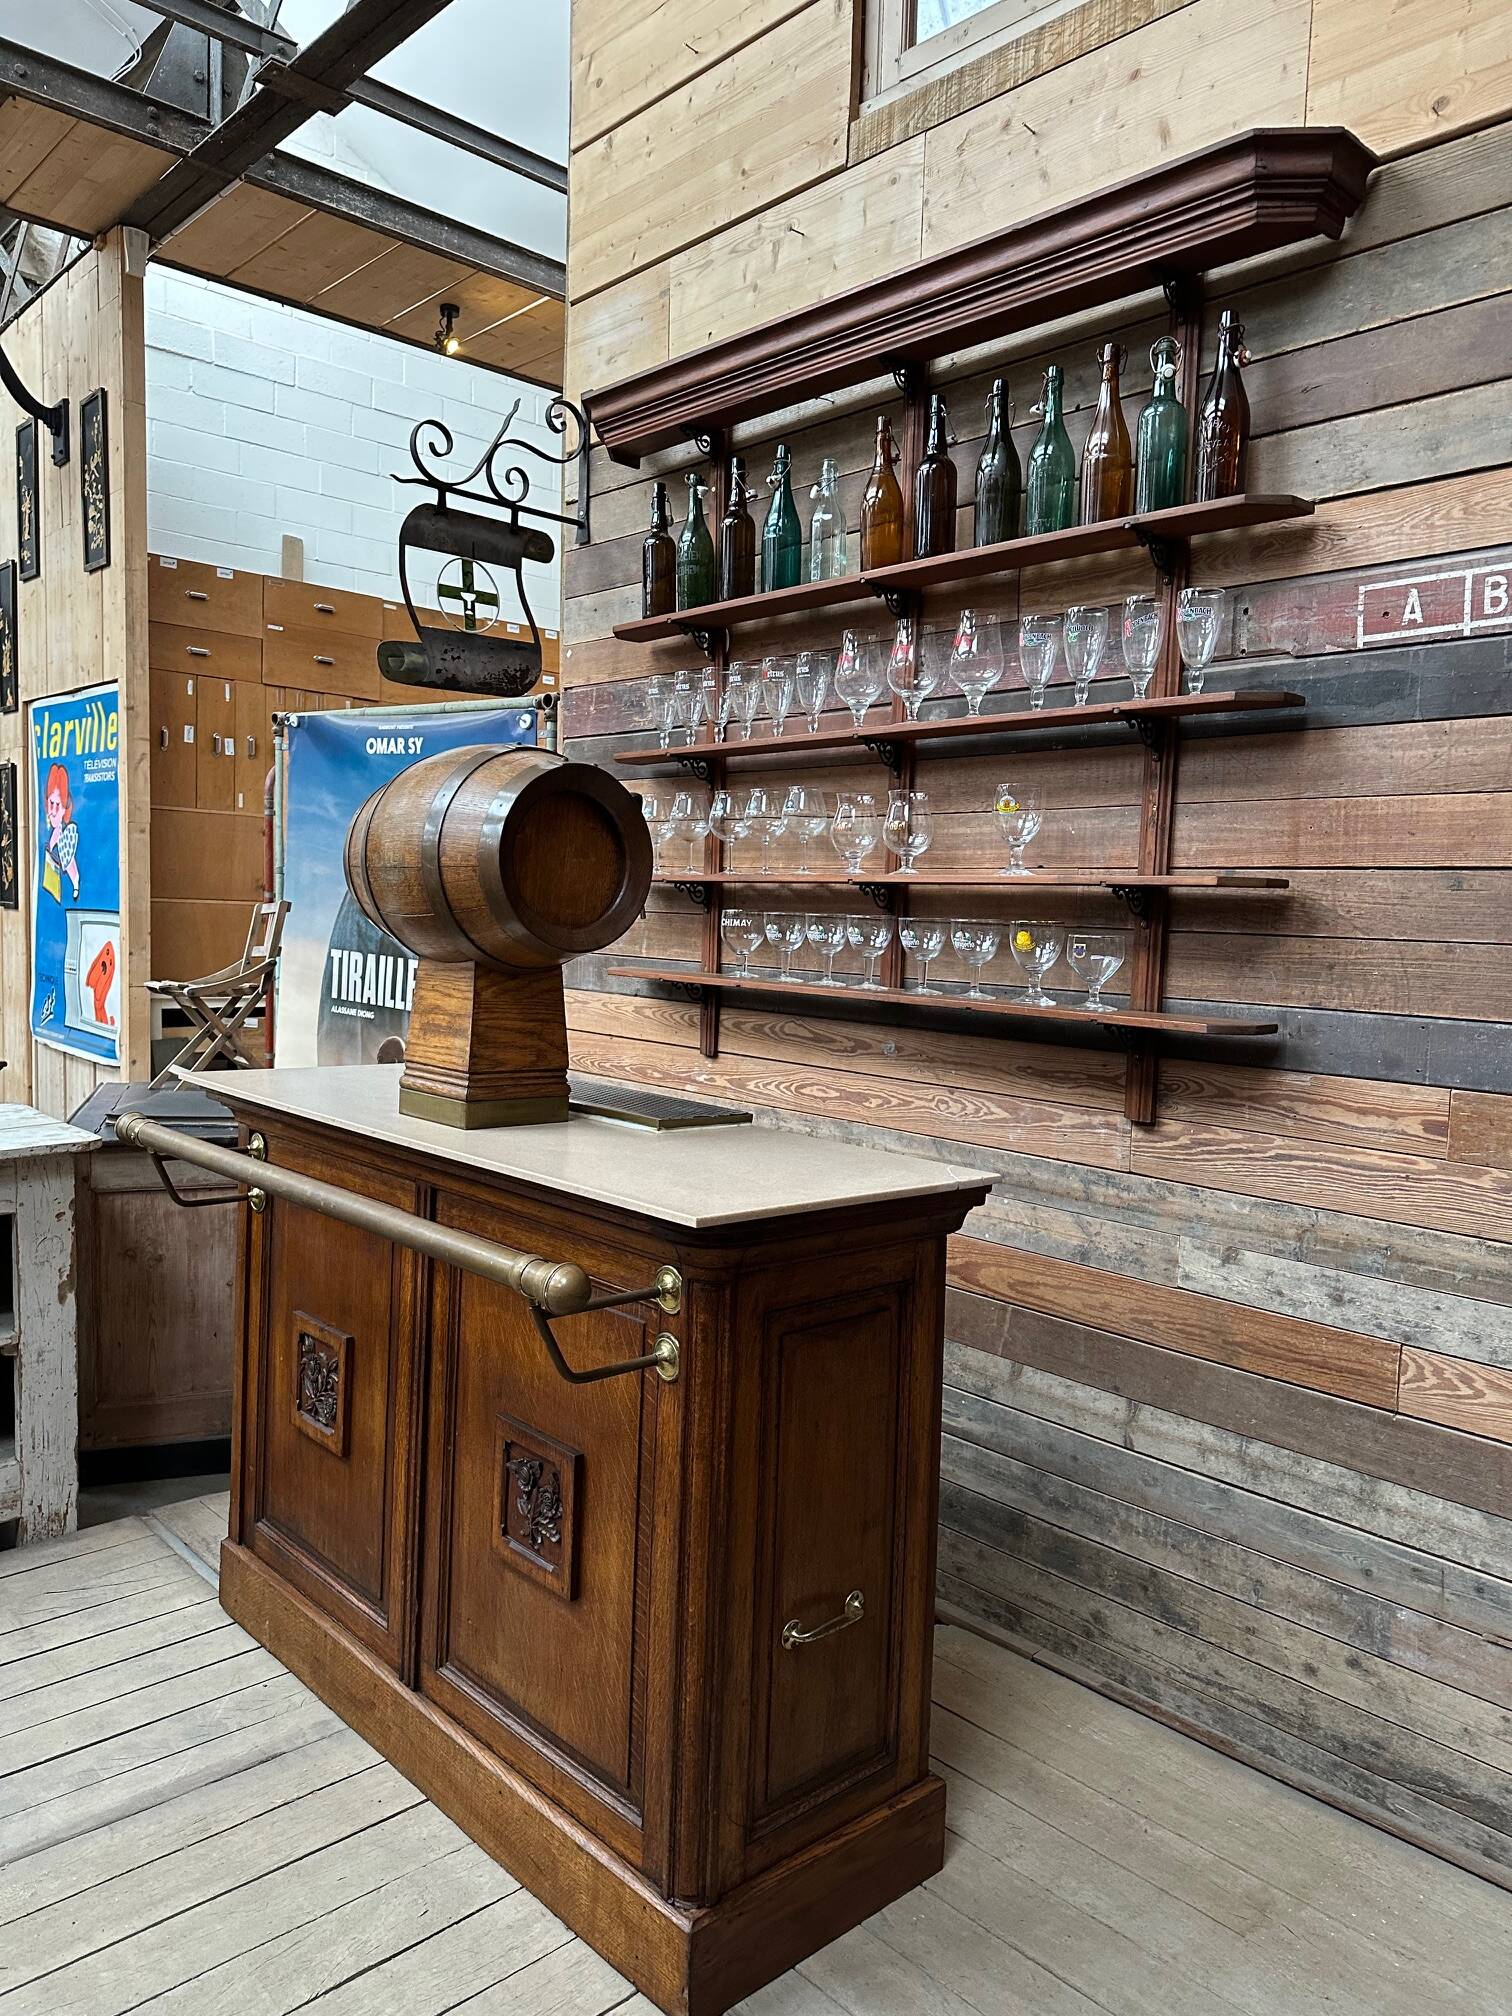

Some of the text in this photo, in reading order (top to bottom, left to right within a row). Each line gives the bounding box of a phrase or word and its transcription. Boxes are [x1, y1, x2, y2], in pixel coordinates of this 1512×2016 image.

[1483, 575, 1509, 615] B
[1402, 588, 1424, 626] A
[365, 737, 424, 755] OMAR SY
[721, 917, 753, 928] CHIMAY
[330, 1005, 375, 1020] ALASSANE DIONG
